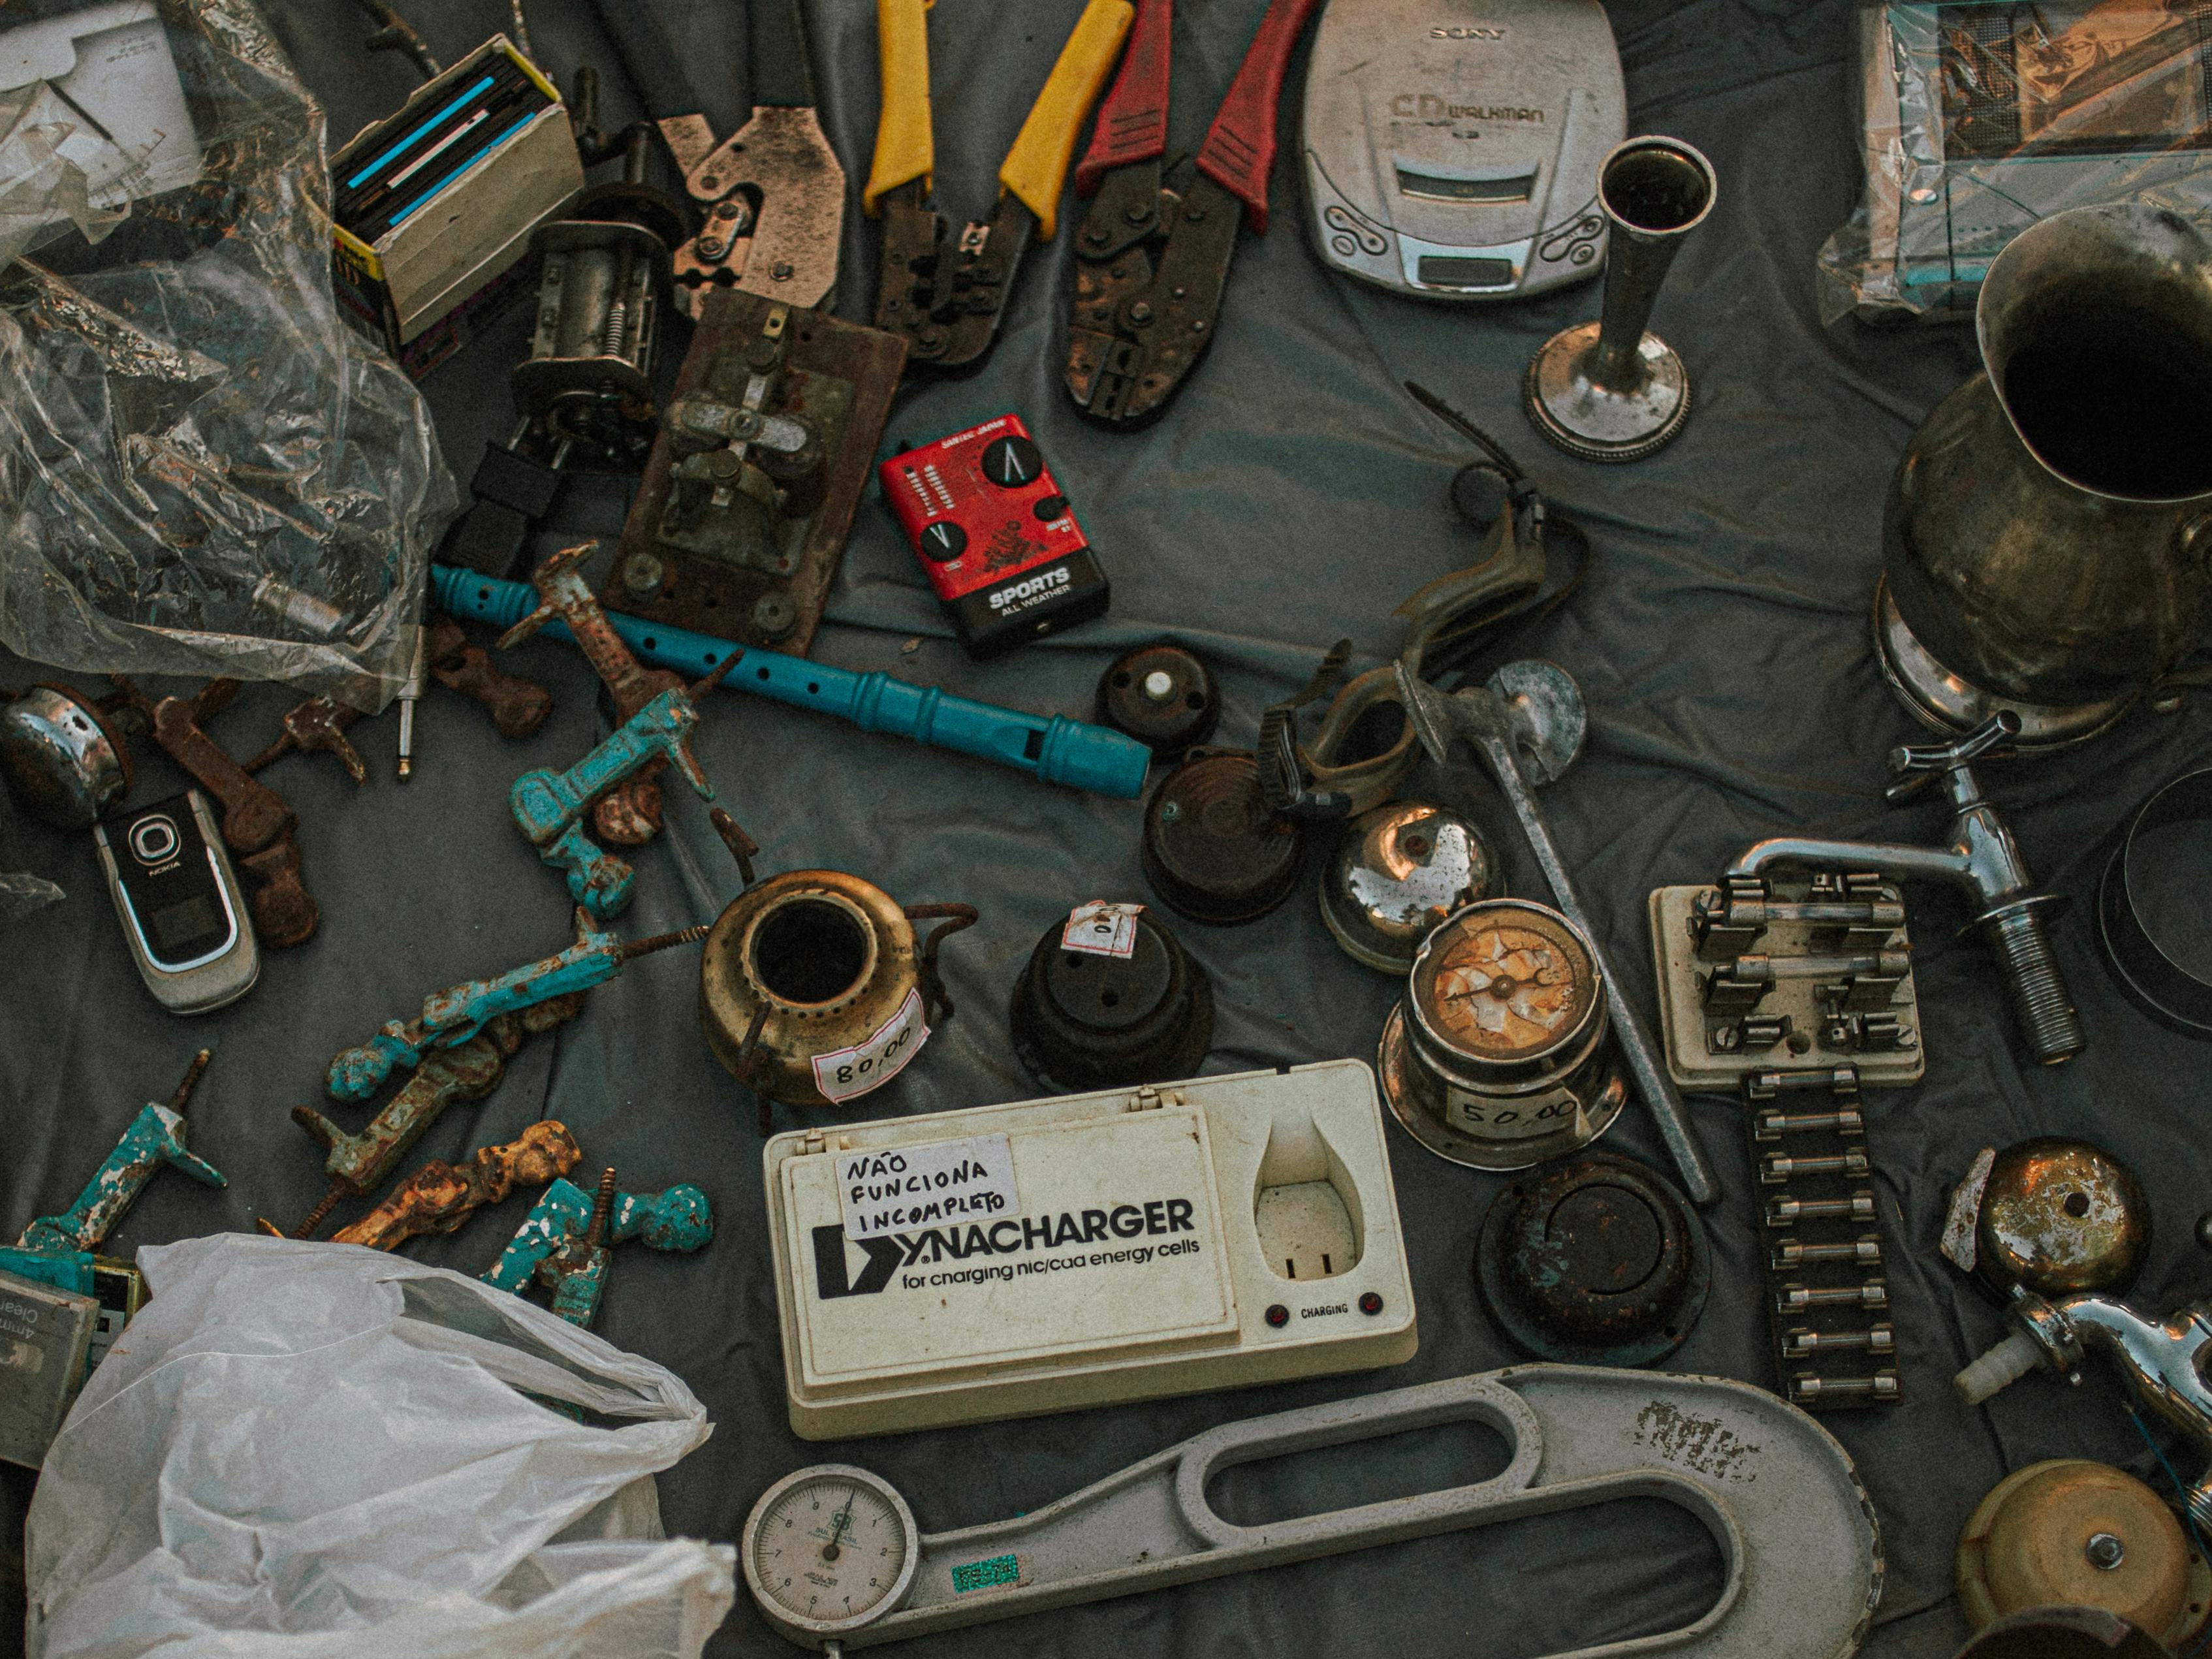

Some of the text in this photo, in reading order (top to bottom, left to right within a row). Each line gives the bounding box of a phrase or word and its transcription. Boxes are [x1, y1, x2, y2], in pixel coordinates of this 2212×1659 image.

[1430, 27, 1505, 40] SONY
[1389, 93, 1444, 118] CD
[989, 567, 1070, 609] SPORTS
[1002, 584, 1071, 616] ALL WEATHER
[149, 861, 181, 877] NOKIA
[836, 1027, 910, 1083] 80,00
[847, 1152, 907, 1180] NÃO
[851, 1160, 988, 1204] FUNCIONA
[860, 1192, 1005, 1232] INCOMPLETO
[902, 1274, 926, 1289] for
[1090, 1246, 1154, 1266] energy
[1157, 1239, 1200, 1256] cells
[1301, 1303, 1348, 1319] CHARGING
[812, 1502, 820, 1510] 9
[785, 1519, 793, 1528] 8
[871, 1519, 877, 1527] 1
[774, 1549, 782, 1558] 7
[880, 1548, 888, 1556] 2
[784, 1578, 792, 1587] 6
[869, 1578, 877, 1587] 3
[810, 1596, 817, 1605] 5
[843, 1596, 850, 1604] 4
